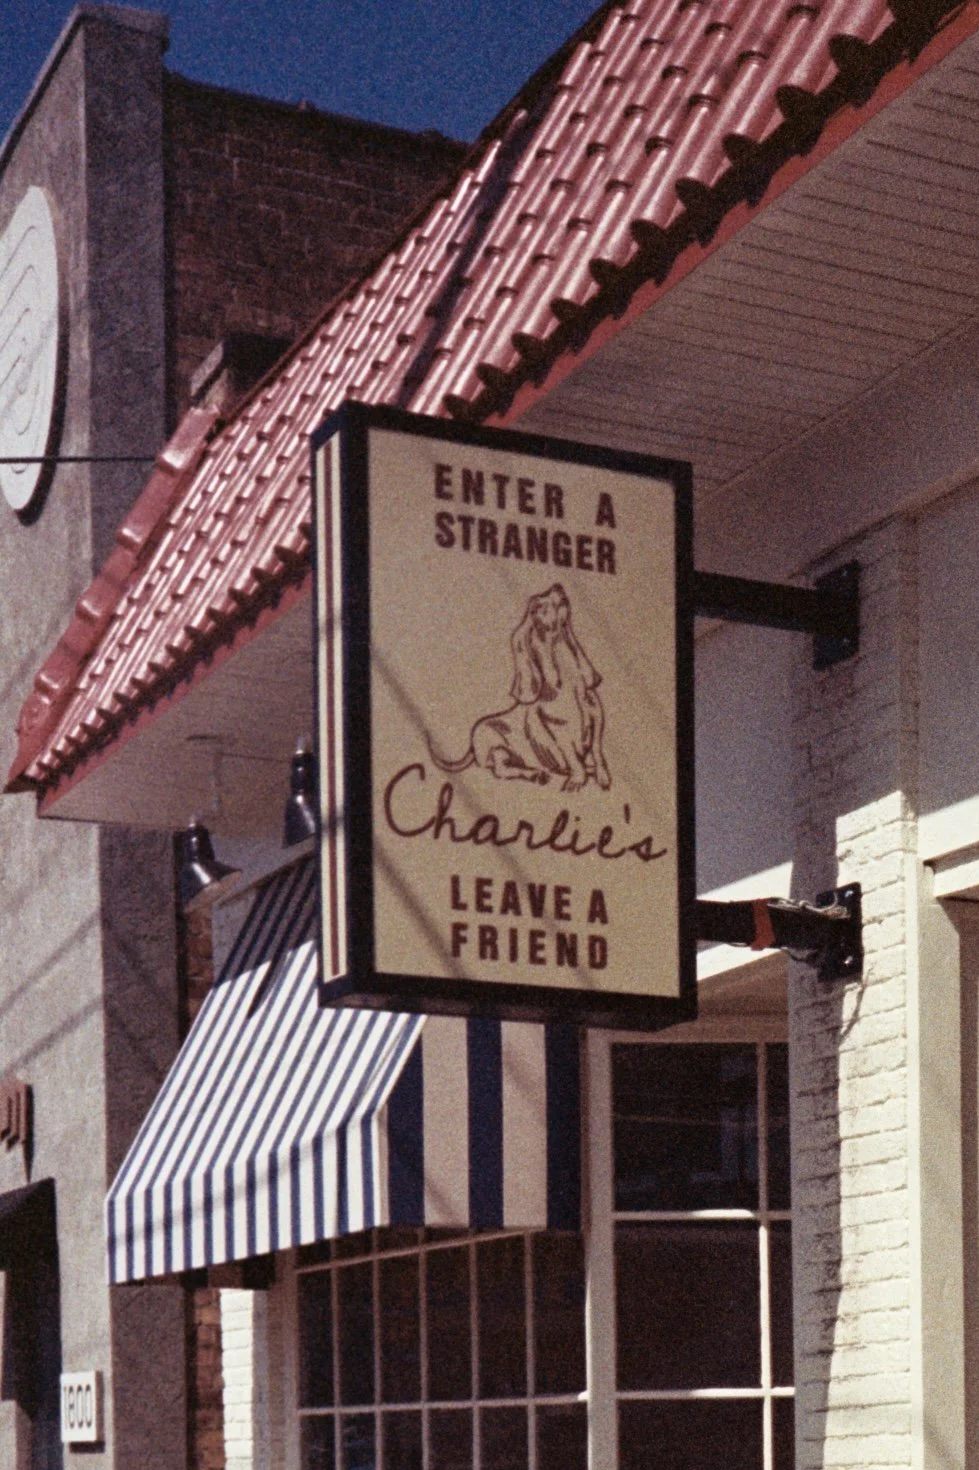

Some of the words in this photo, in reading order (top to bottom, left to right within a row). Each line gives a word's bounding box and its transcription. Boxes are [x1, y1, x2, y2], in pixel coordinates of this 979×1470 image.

[434, 463, 564, 519] ENTER
[595, 492, 616, 529] A
[434, 511, 616, 575] STRANGER
[384, 763, 667, 862] Charlie's
[451, 874, 571, 921] LEAVE
[587, 888, 608, 924] A
[451, 922, 608, 970] FRIEND
